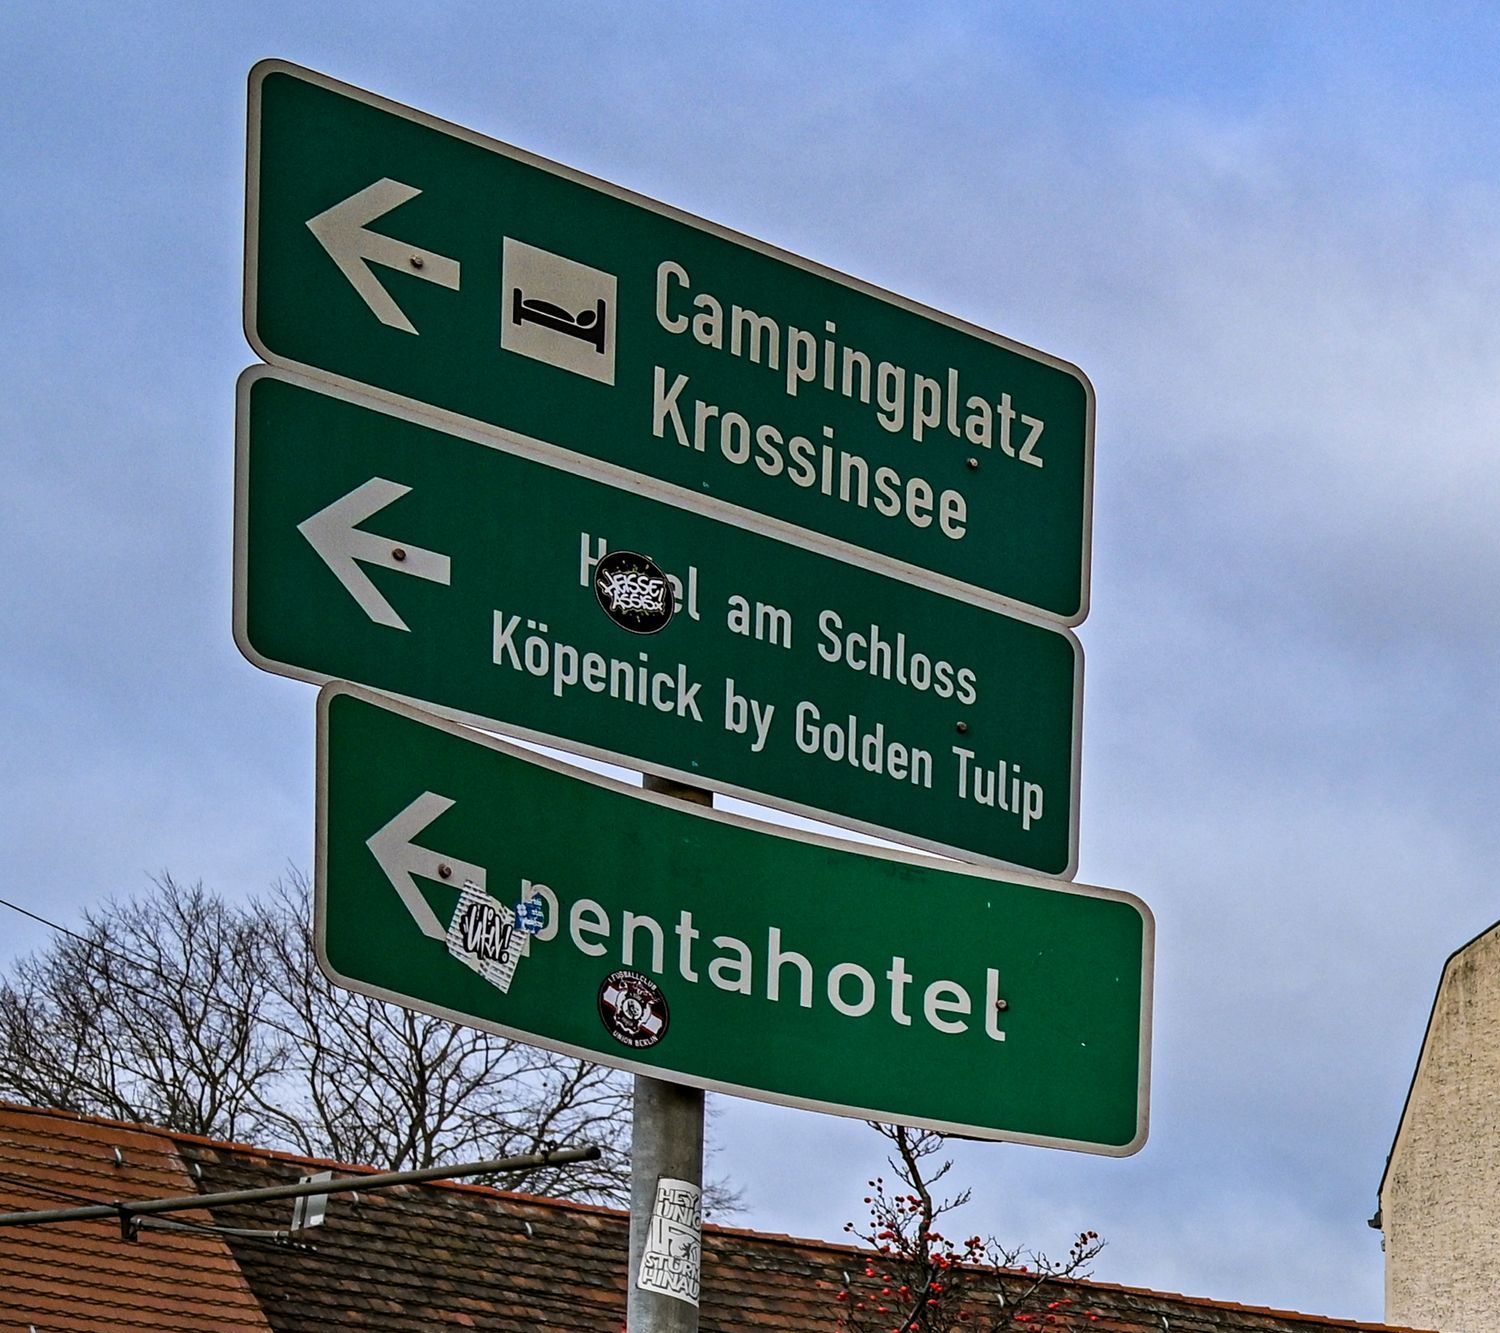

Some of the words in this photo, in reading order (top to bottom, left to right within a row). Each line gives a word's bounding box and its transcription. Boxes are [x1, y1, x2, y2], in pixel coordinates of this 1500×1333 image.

[655, 260, 1044, 468] Campingplatz
[652, 365, 967, 539] Krossinsee
[580, 532, 700, 621] Hel
[727, 595, 793, 649] am
[817, 610, 978, 704] Schloss
[492, 610, 703, 721] Köpenick
[724, 679, 775, 752] by
[795, 701, 932, 788] Golden
[952, 745, 1044, 831] Tulip
[521, 879, 1006, 1042] pentahotel
